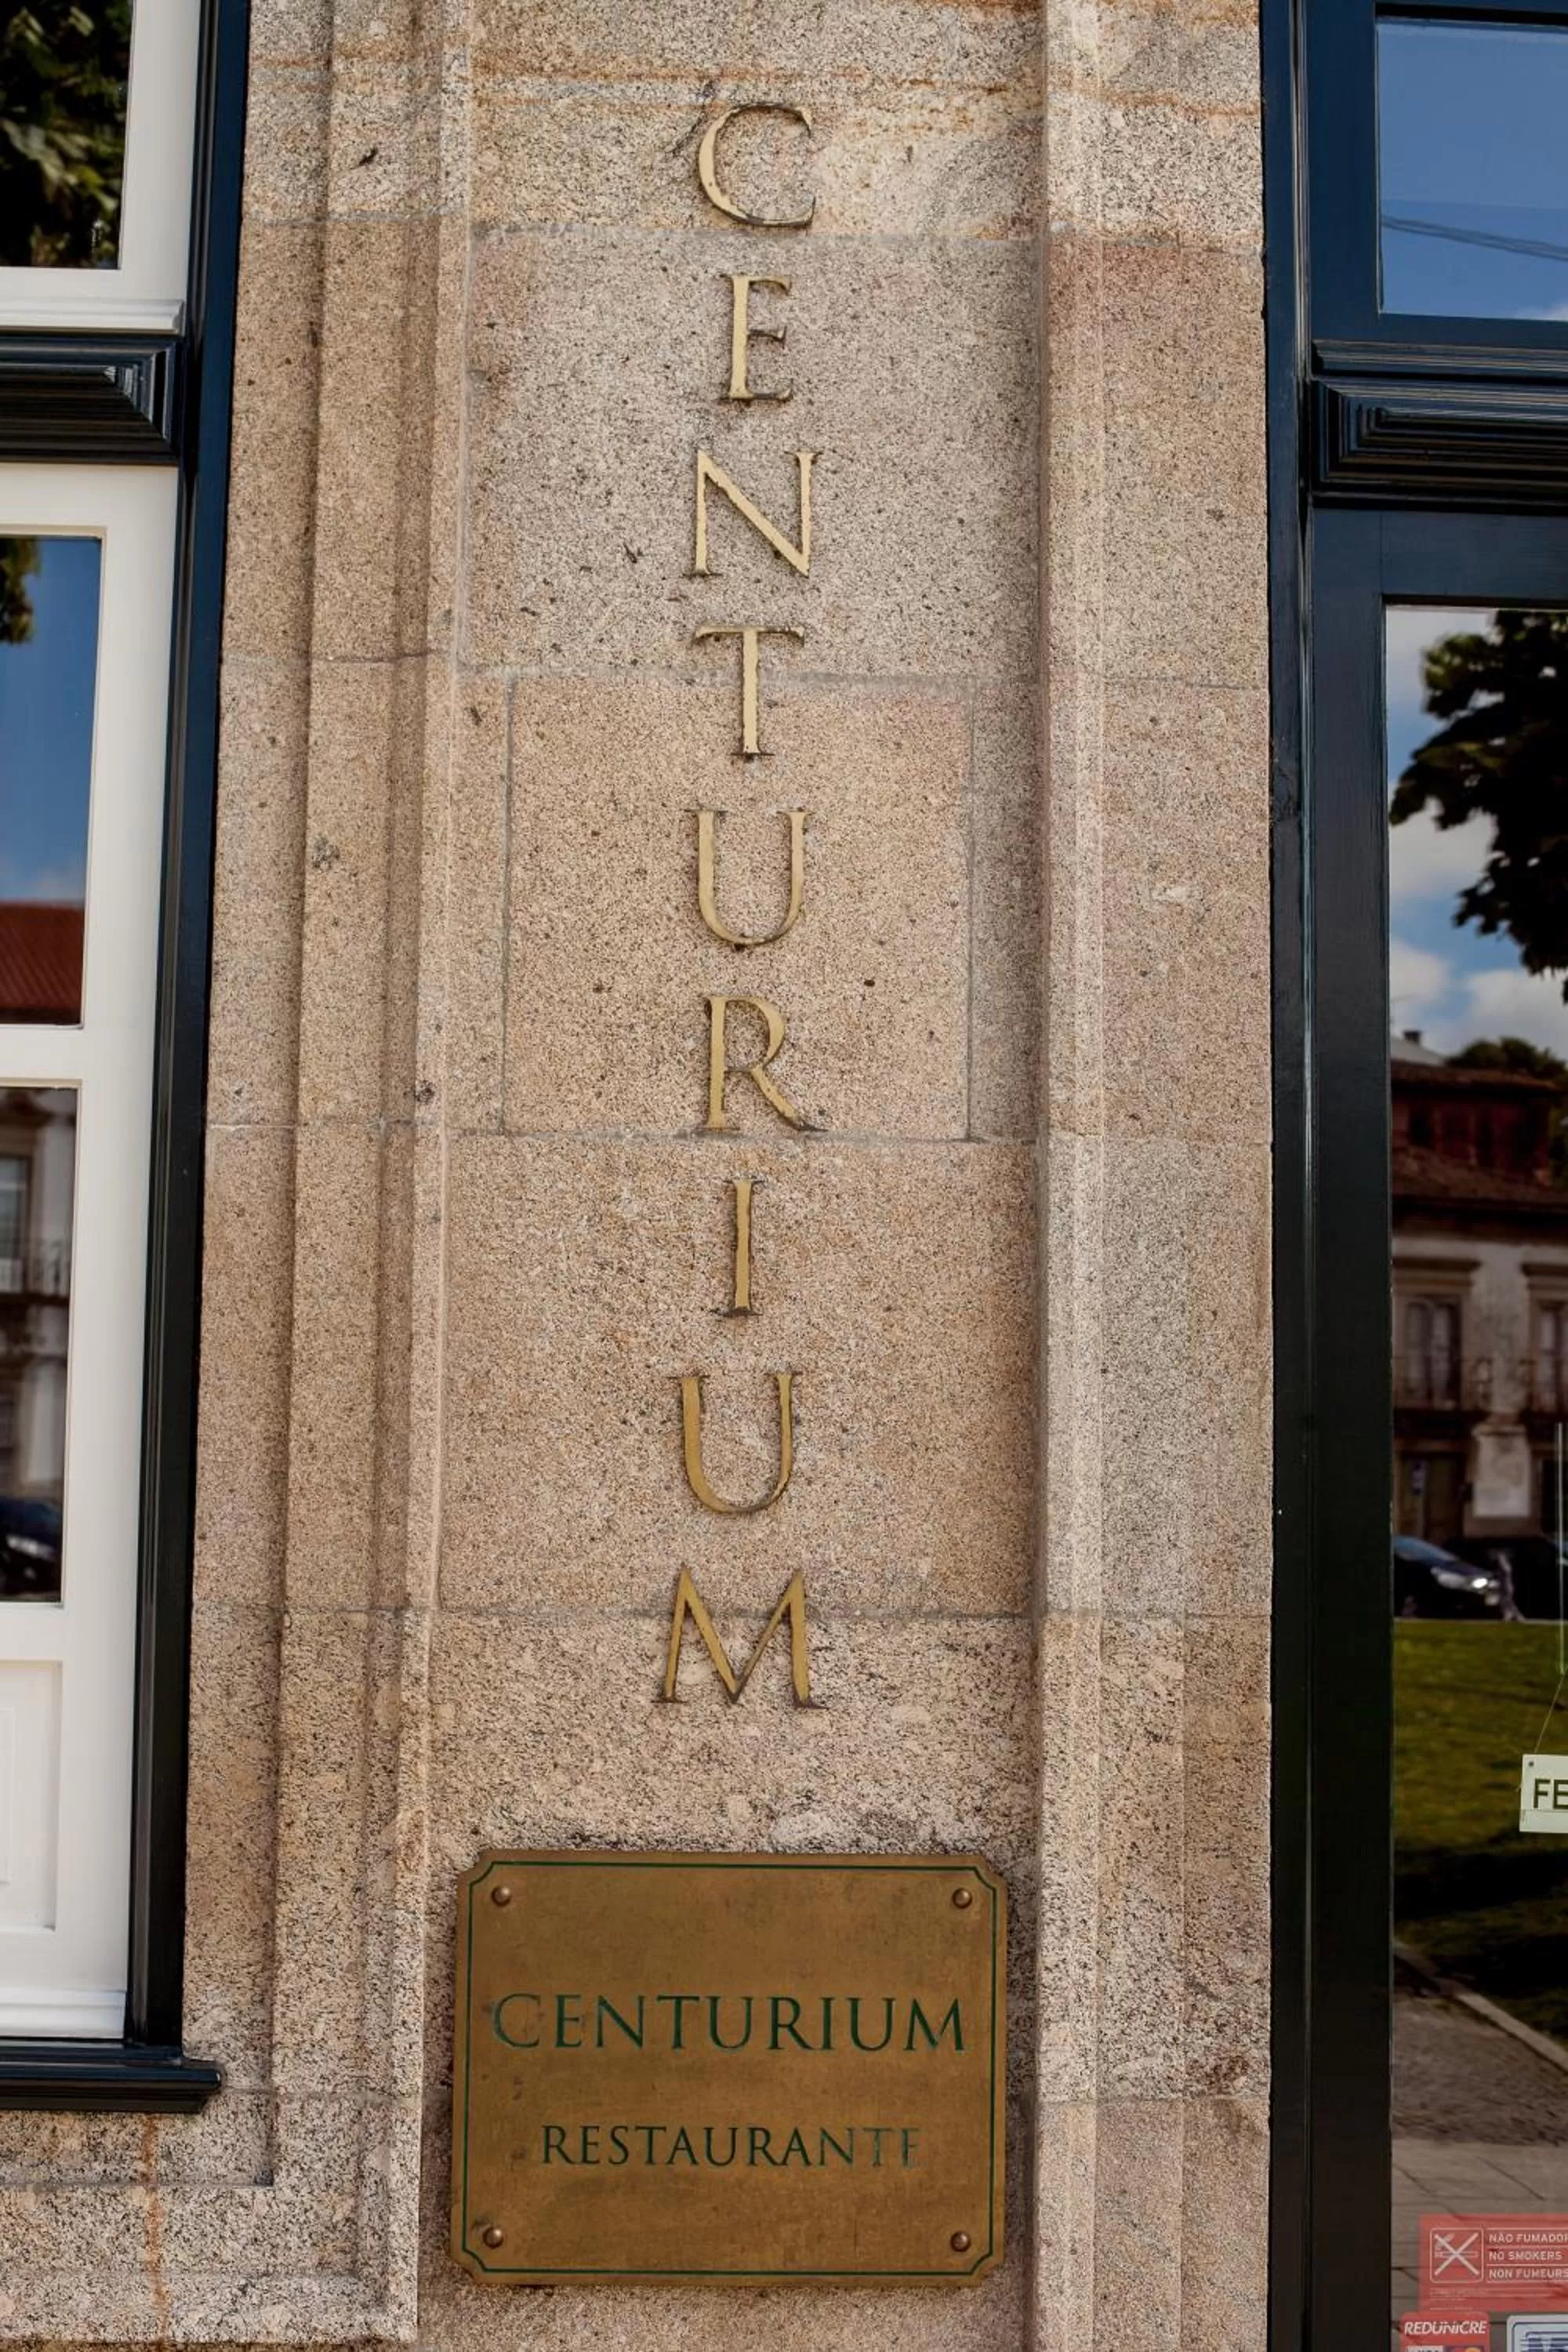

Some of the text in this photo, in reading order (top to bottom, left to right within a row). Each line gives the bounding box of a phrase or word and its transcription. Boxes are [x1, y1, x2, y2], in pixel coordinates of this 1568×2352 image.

[652, 101, 828, 1710] CENTURIUM
[492, 1992, 965, 2052] CENTURIUM
[541, 2124, 921, 2168] RESTAURANTE
[1489, 2232, 1513, 2243] NÃO
[1489, 2251, 1563, 2261] NO SMOKERS
[1489, 2268, 1513, 2278] NON
